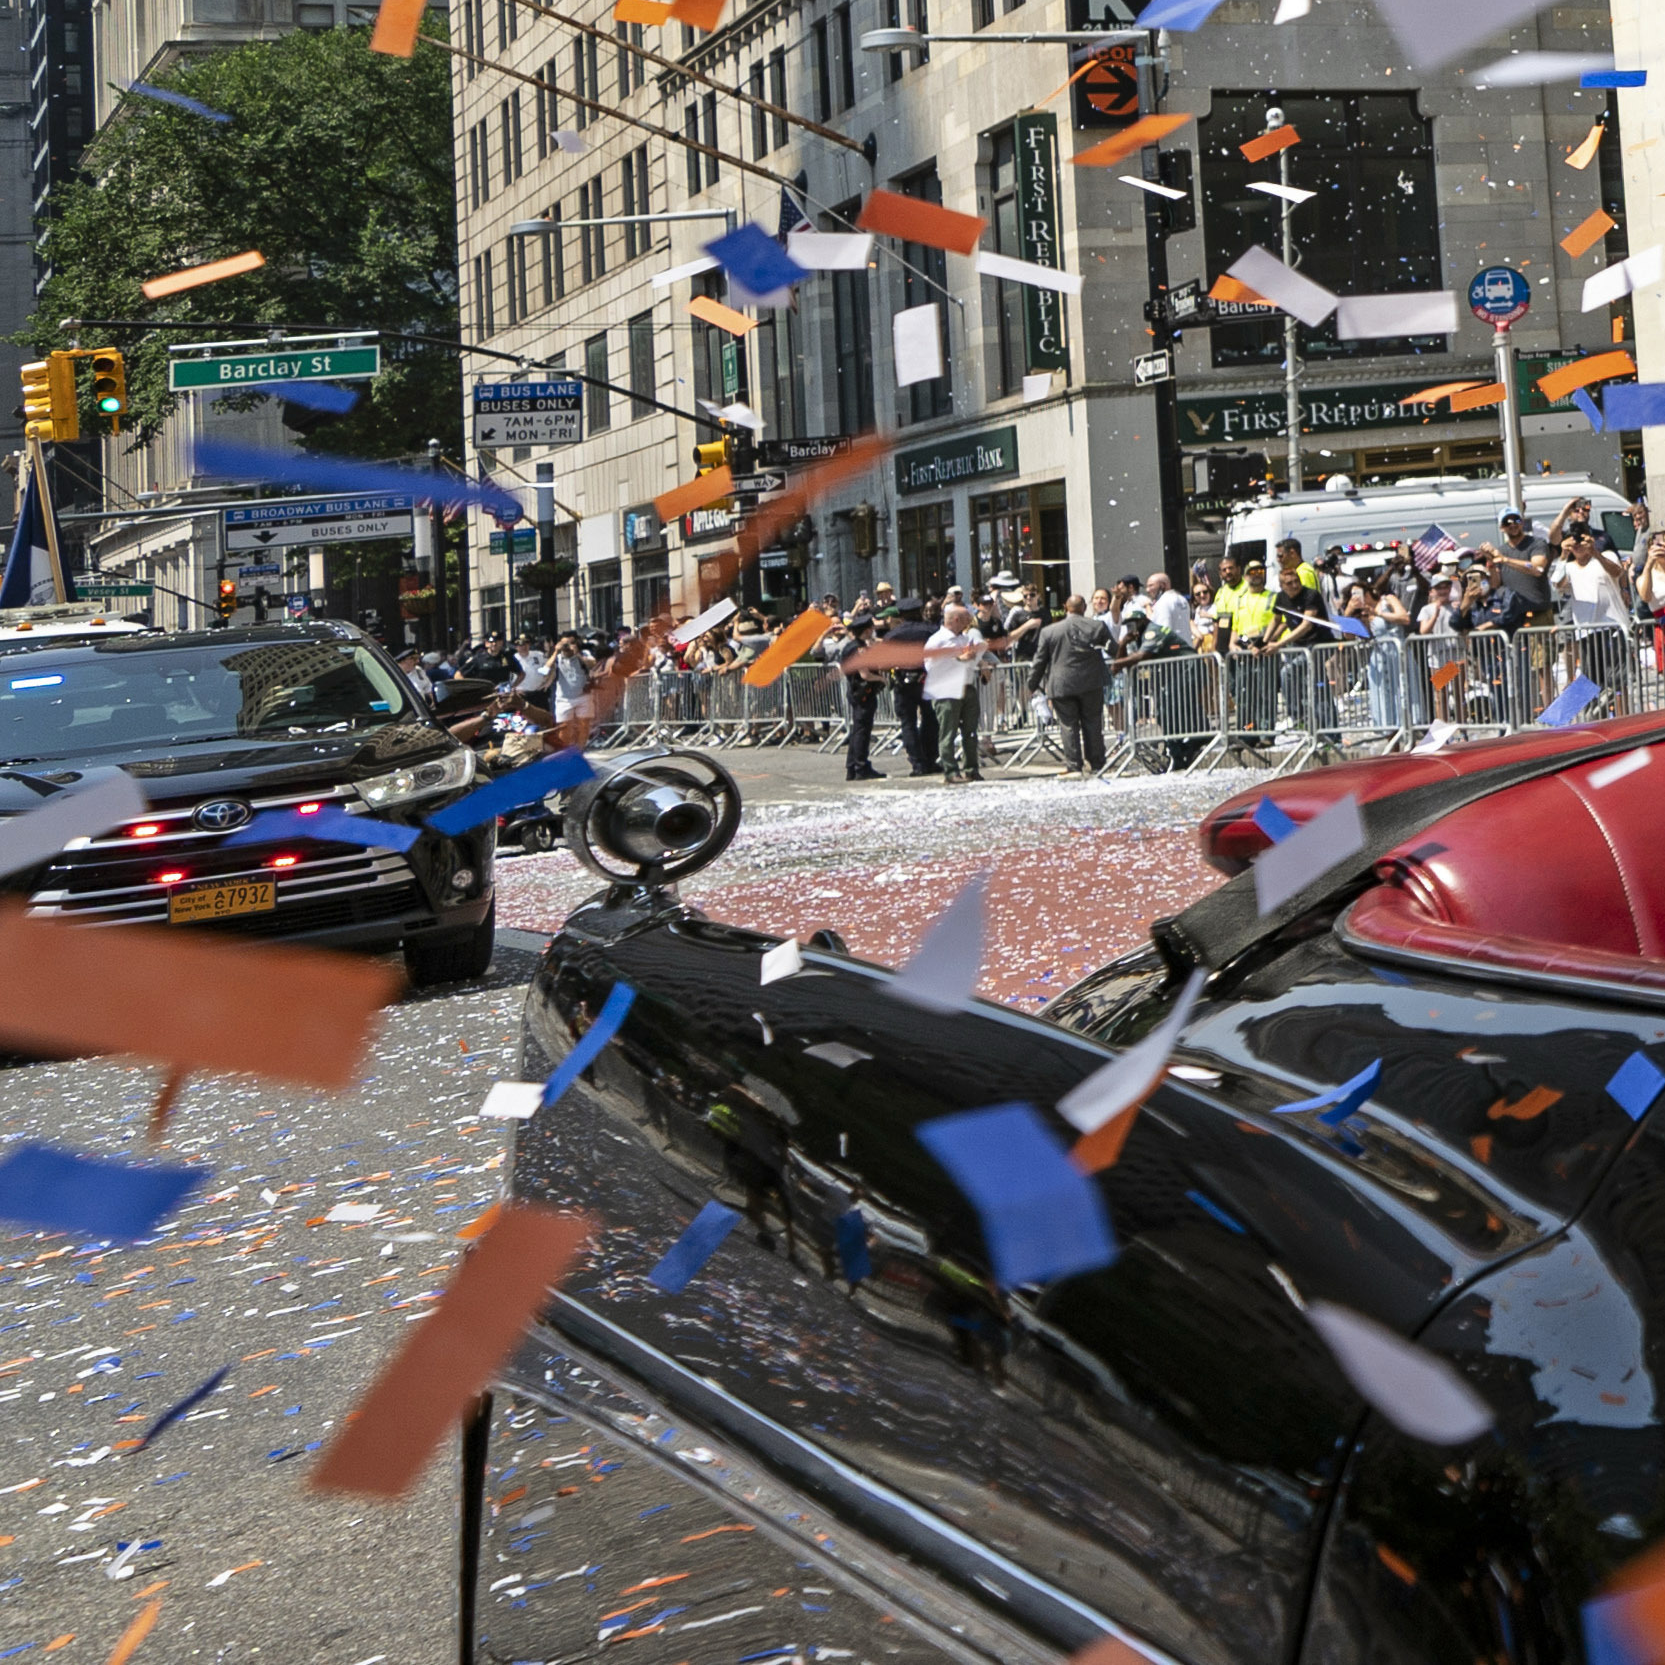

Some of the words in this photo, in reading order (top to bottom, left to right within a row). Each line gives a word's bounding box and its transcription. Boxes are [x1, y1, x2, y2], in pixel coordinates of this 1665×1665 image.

[1028, 127, 1048, 213] FIRST
[1028, 220, 1056, 353] REPBLIC
[219, 359, 302, 380] Barclay
[311, 355, 332, 373] St
[500, 385, 531, 398] BUS
[537, 383, 577, 396] LANE
[480, 399, 531, 412] BUSES
[536, 398, 575, 410] ONLY
[1222, 409, 1288, 432] FIRS
[1310, 402, 1437, 425] REPUBLIC
[790, 444, 837, 458] Barclay
[933, 455, 975, 481] REPUBLIC
[976, 445, 1003, 472] BANK
[251, 504, 321, 519] BROADWAY
[326, 502, 350, 512] BUS
[355, 500, 389, 510] LANE
[312, 525, 352, 537] BUSES
[357, 522, 389, 534] ONLY
[228, 884, 269, 907] 7932
[194, 902, 211, 911] York
